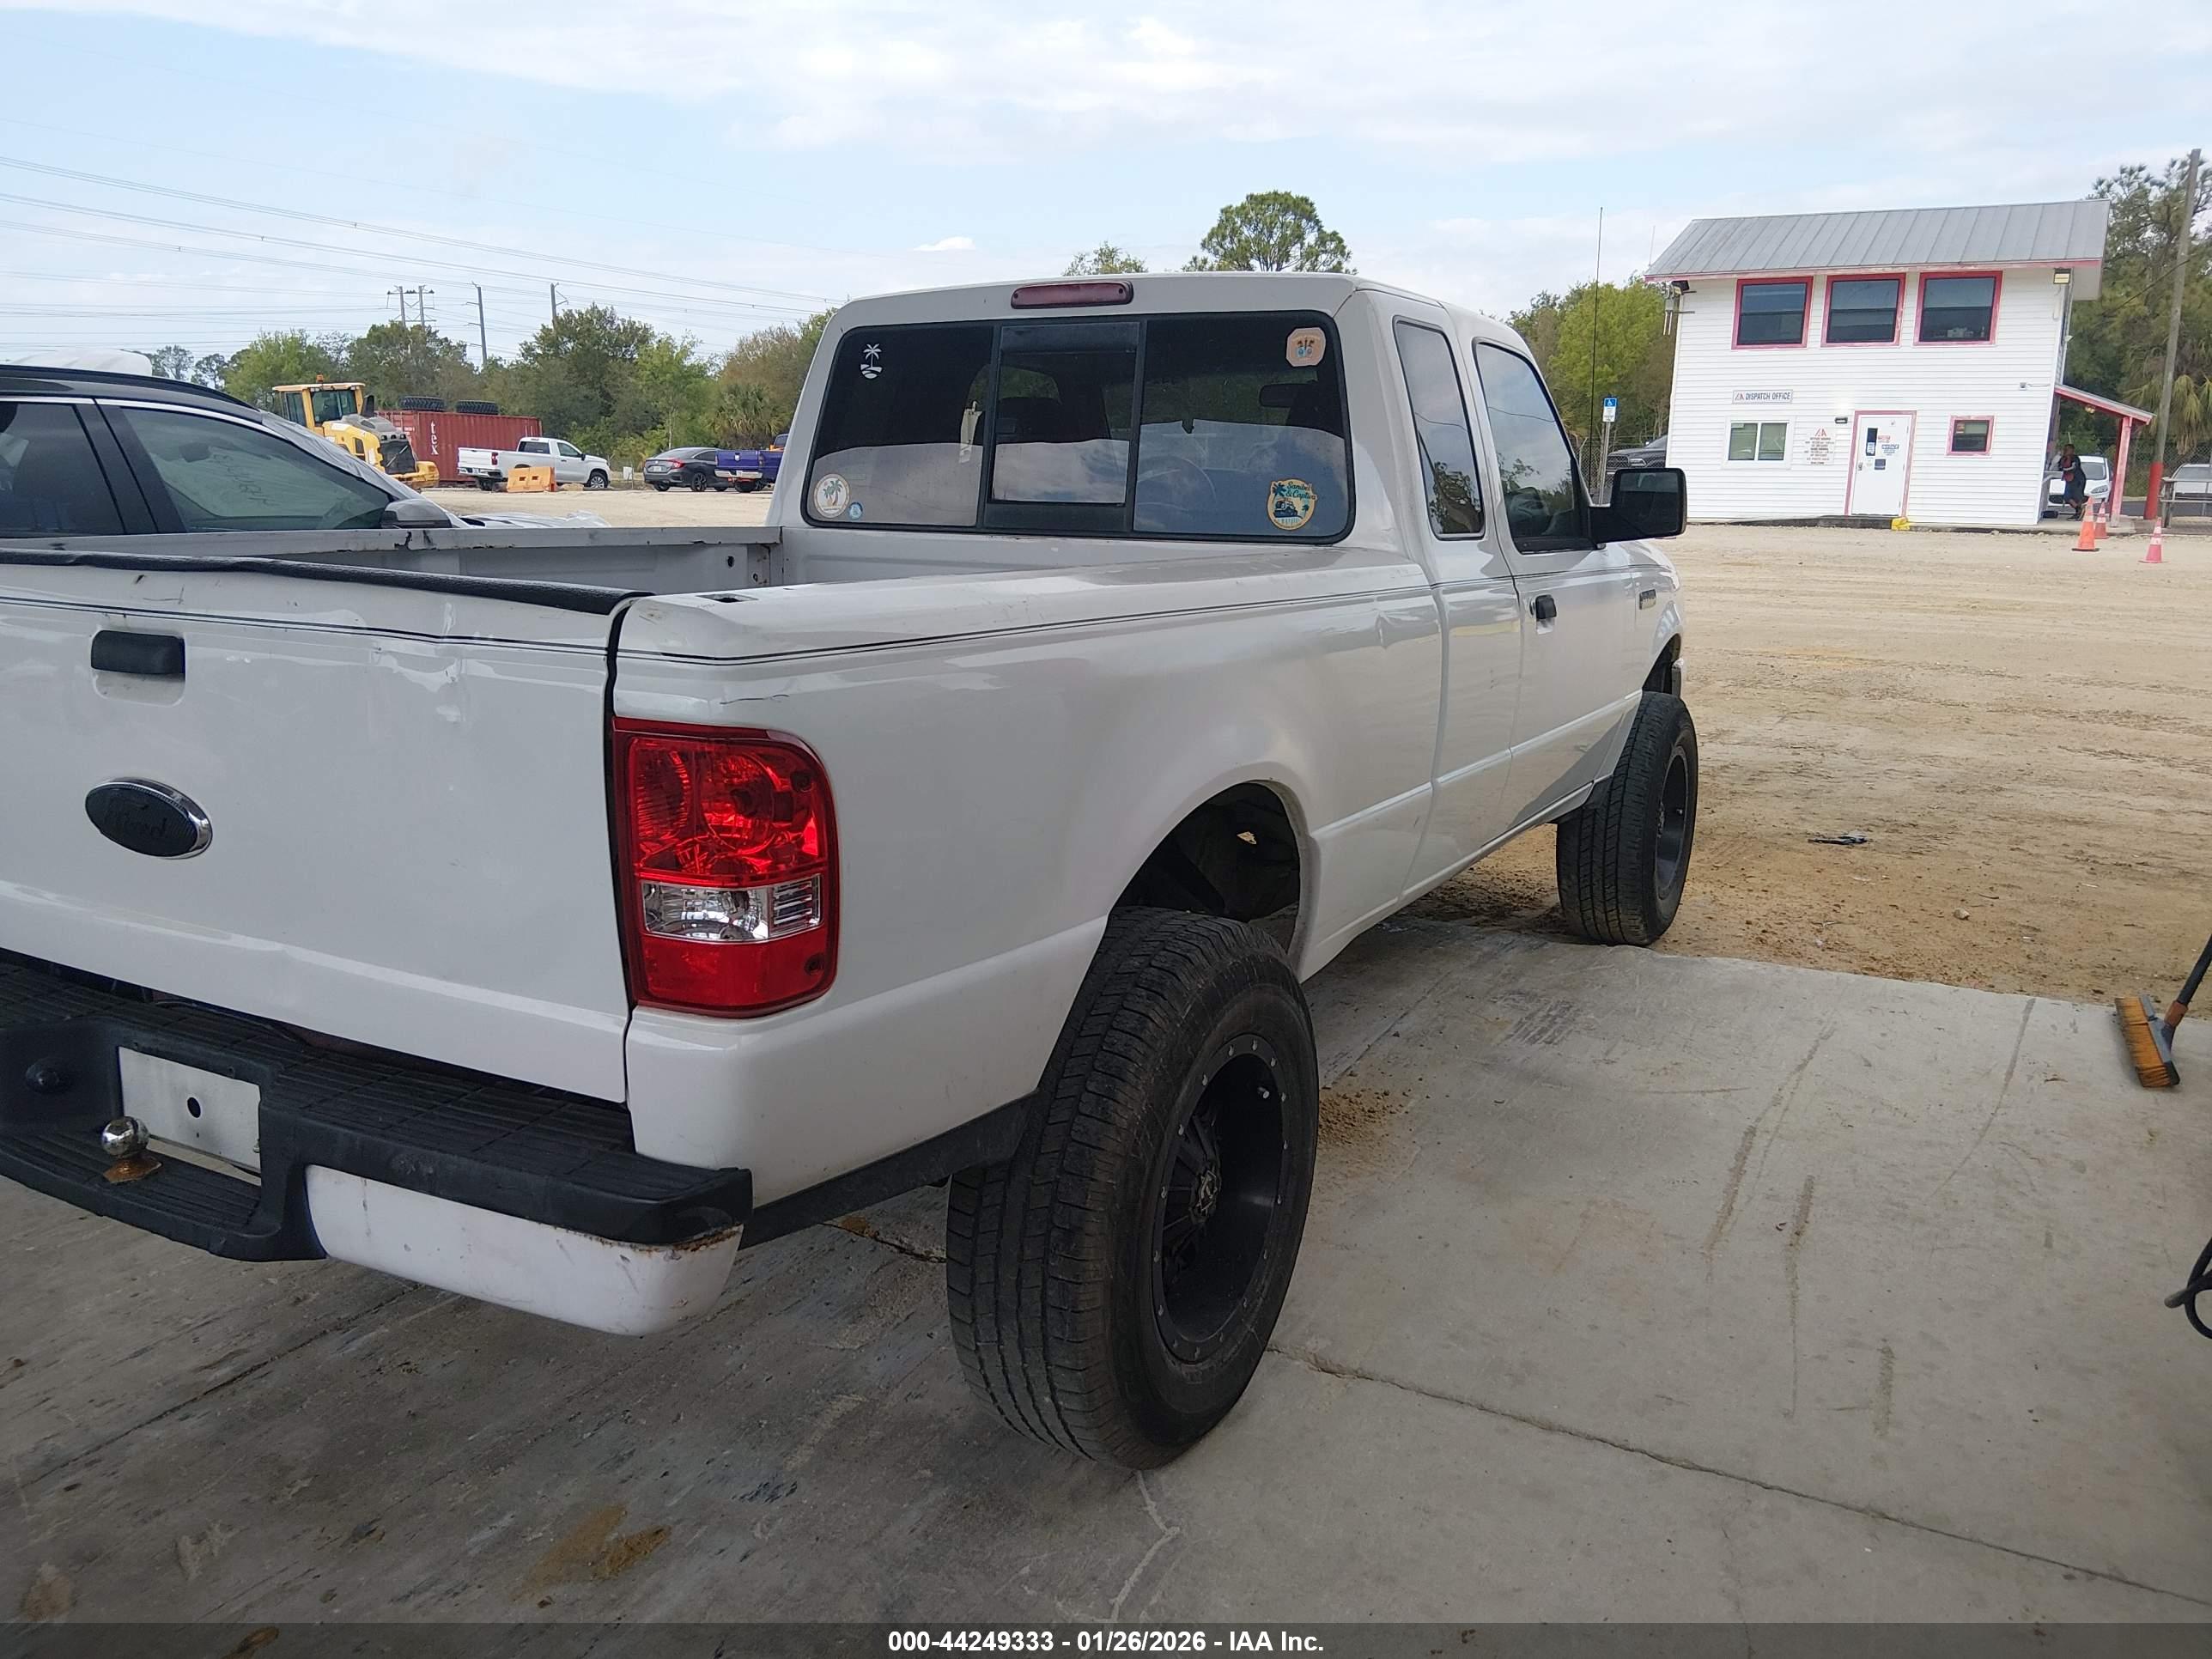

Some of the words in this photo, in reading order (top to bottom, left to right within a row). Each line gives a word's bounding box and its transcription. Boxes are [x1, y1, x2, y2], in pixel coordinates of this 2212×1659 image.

[1745, 392, 1770, 400] DISPATCH
[1771, 392, 1790, 400] OFFICE
[430, 420, 439, 455] tex
